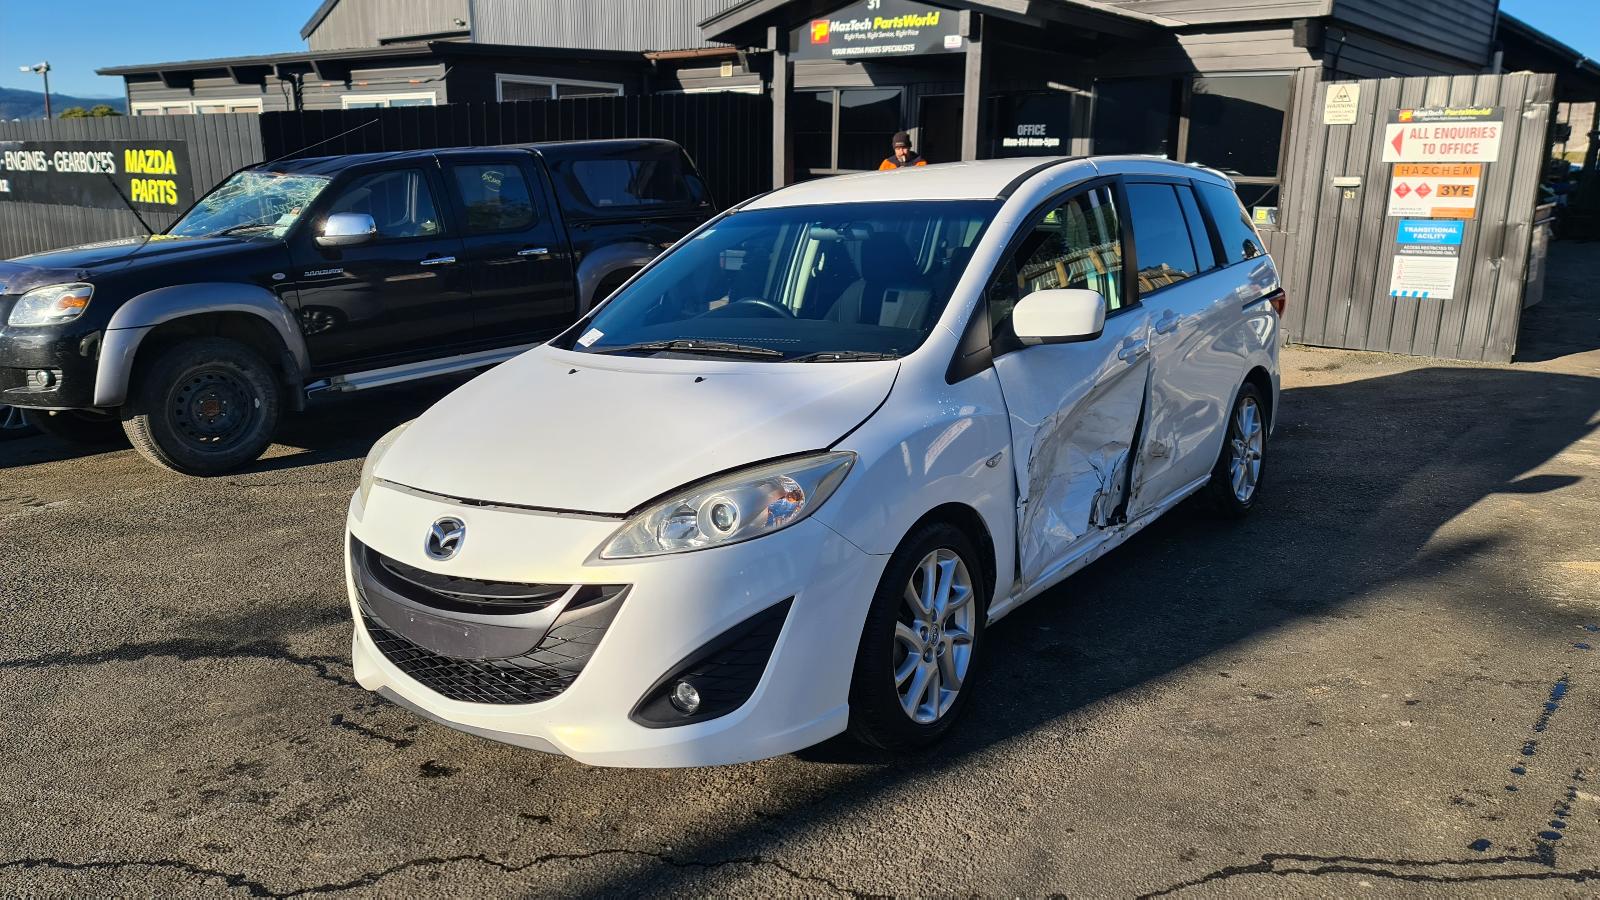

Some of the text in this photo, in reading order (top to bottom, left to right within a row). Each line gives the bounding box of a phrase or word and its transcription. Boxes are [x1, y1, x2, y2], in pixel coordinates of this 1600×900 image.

[867, 0, 881, 10] 31
[830, 11, 940, 32] MazTech PartsWorld
[881, 44, 915, 53] SPECIALISTS
[1017, 124, 1046, 136] OFFICE
[1409, 126, 1497, 140] ALL ENQUIRIES
[1422, 142, 1479, 155] TO OFFICE
[5, 150, 116, 174] ENGINES GEARBOXES
[124, 149, 178, 175] MAZDA
[1400, 166, 1473, 175] HAZCHEM
[131, 178, 178, 206] PARTS
[1344, 191, 1355, 199] 31
[1441, 185, 1470, 197] 3YE
[1403, 226, 1457, 234] TRANSITIONAL
